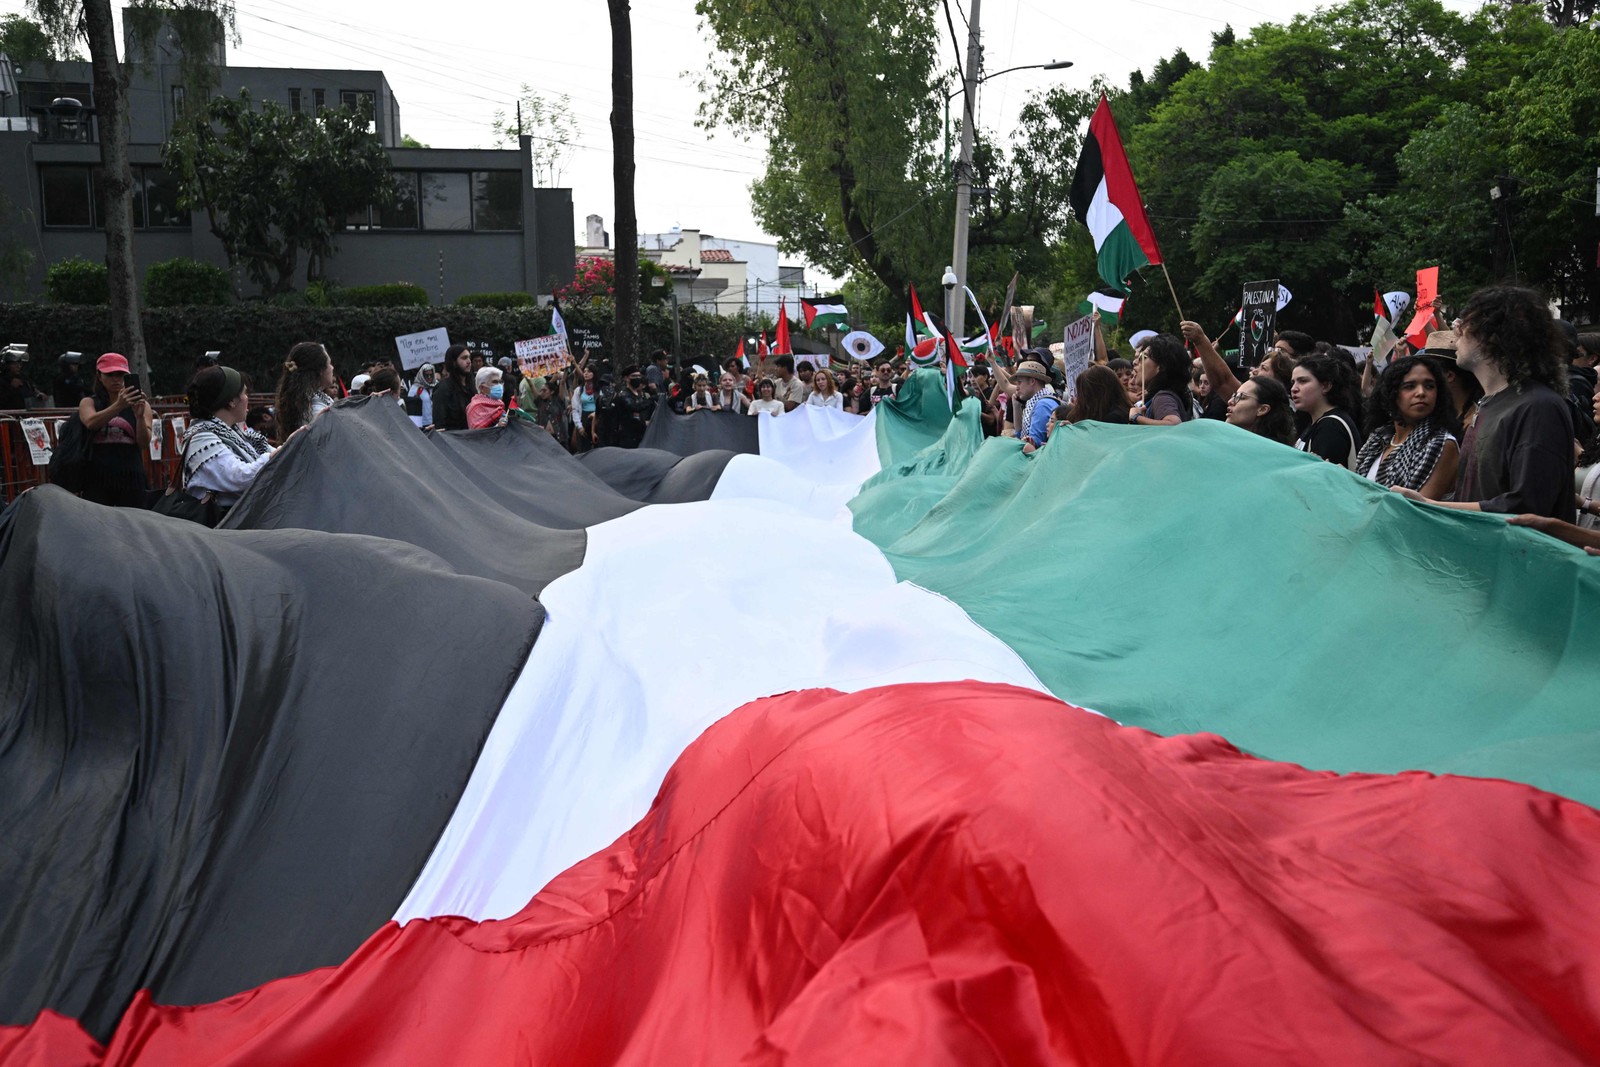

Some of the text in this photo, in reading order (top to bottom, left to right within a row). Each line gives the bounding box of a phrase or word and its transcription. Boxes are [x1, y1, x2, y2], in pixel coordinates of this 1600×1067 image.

[1244, 290, 1275, 305] PALESTINA
[410, 344, 439, 356] nombre
[582, 340, 603, 348] AHORA
[1252, 343, 1259, 358] Y
[525, 352, 560, 364] NORMAL
